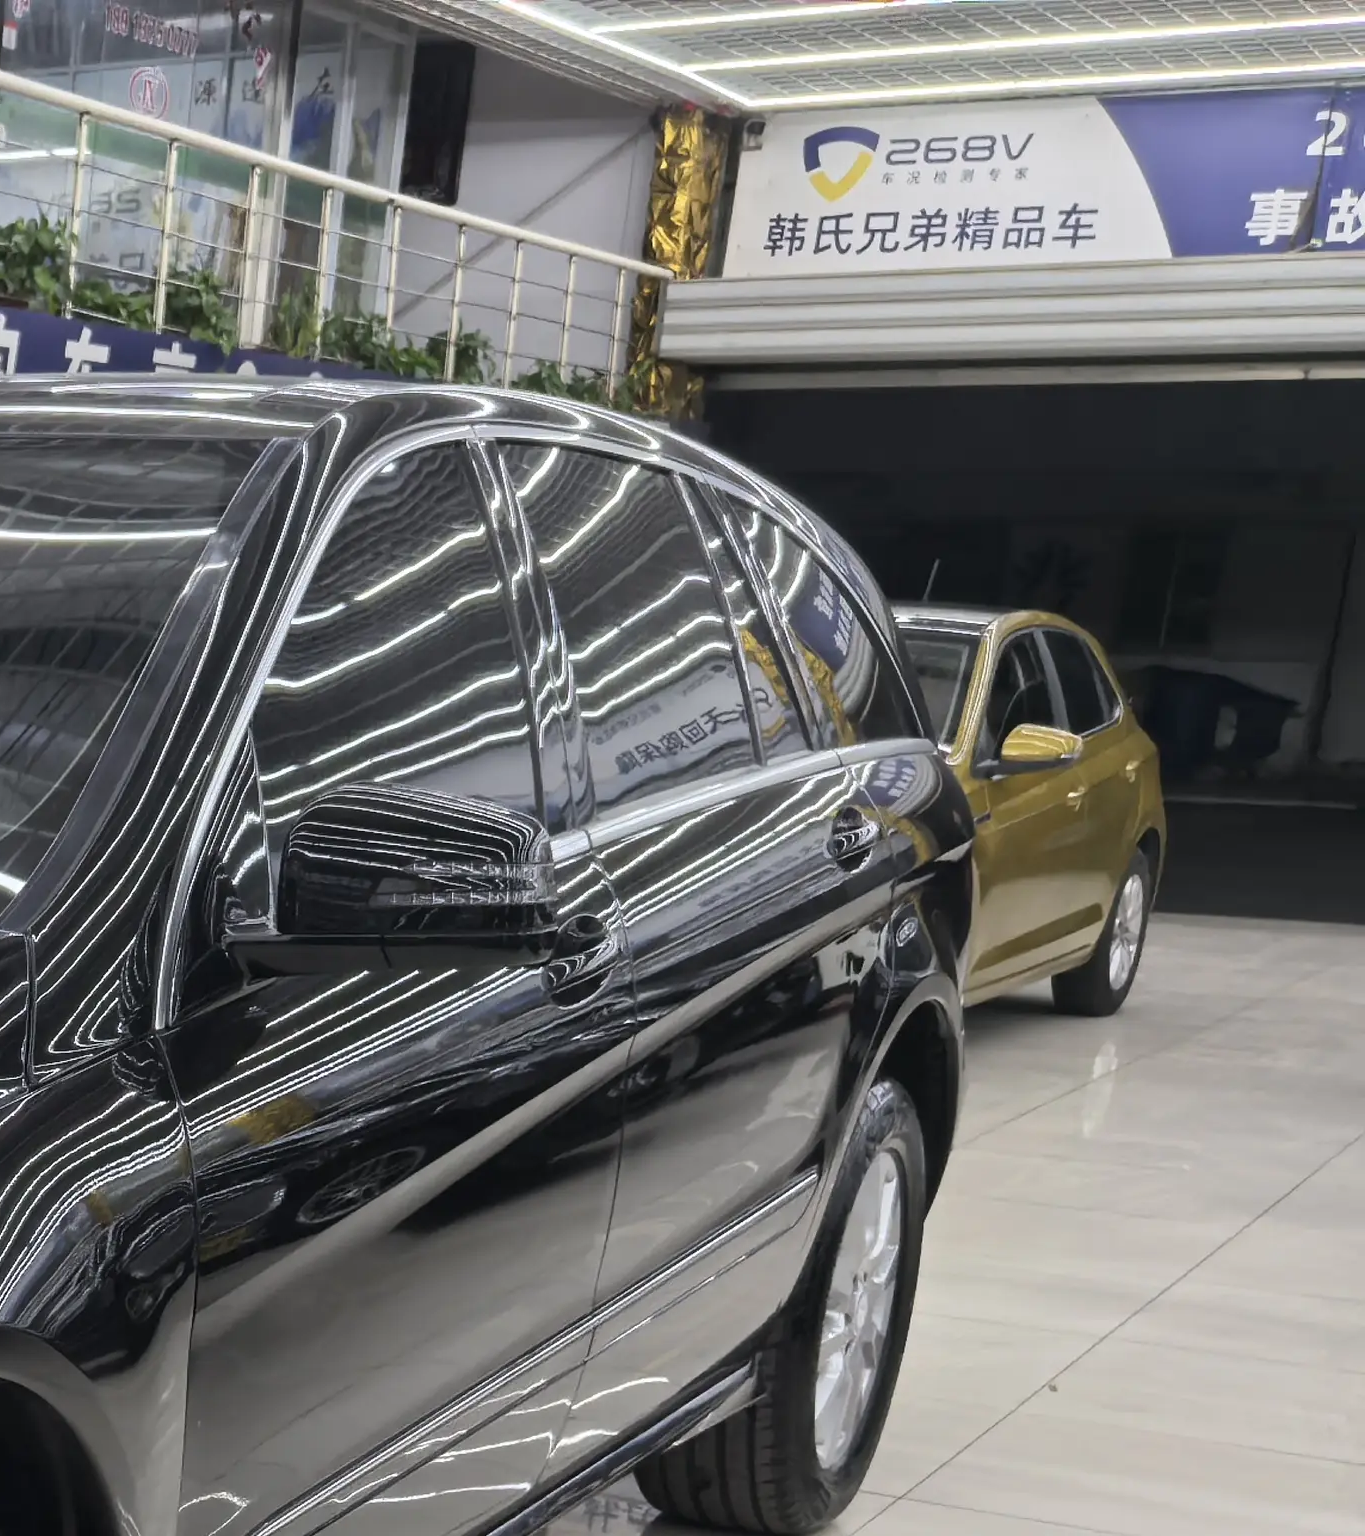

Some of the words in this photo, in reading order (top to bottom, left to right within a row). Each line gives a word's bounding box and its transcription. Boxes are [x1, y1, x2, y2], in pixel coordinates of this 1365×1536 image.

[885, 133, 1034, 166] 268V
[1306, 110, 1365, 156] 2
[881, 167, 1029, 185] 车况检测专家
[763, 203, 1099, 257] 韩氏兄弟精品车
